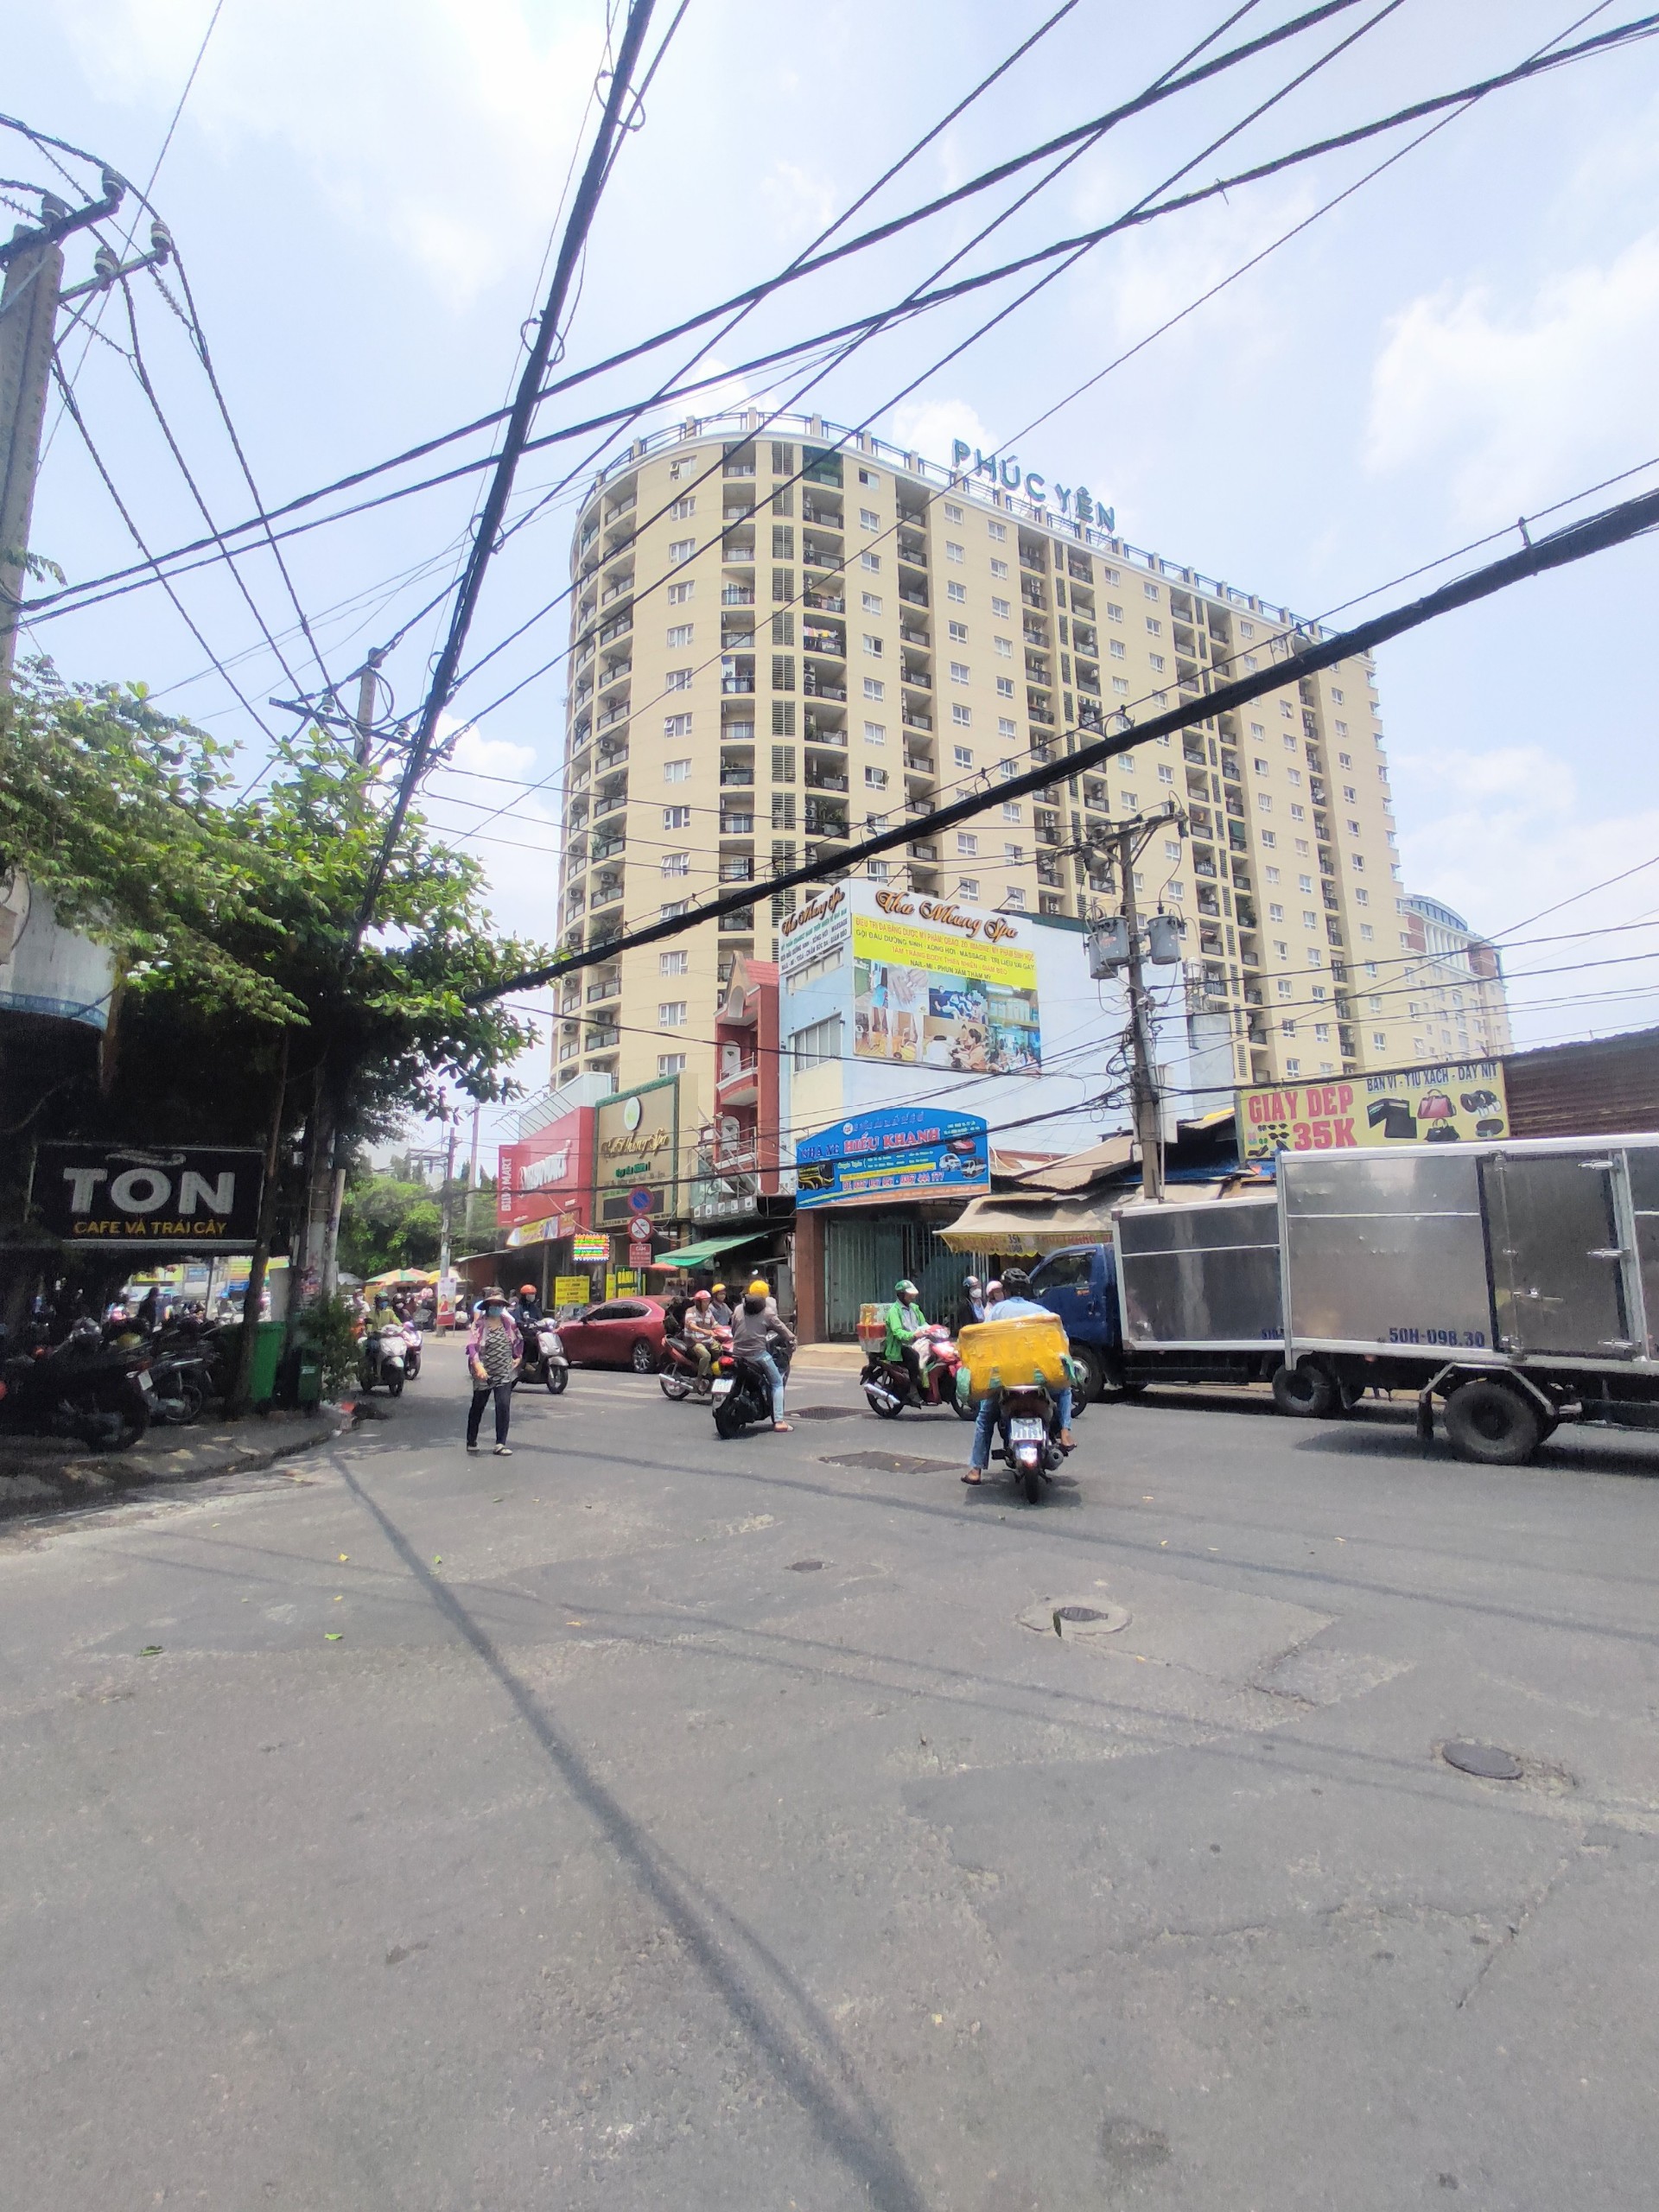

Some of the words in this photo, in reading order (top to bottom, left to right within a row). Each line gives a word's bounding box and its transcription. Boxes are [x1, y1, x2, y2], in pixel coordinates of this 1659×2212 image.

[952, 438, 1046, 502] PHÚC
[1055, 483, 1115, 533] YÊN
[875, 889, 915, 914] Thu
[919, 900, 982, 938] Nhung
[984, 917, 1019, 943] Spa
[882, 1128, 940, 1149] KHANH
[1293, 1118, 1357, 1151] 35K
[501, 1157, 512, 1185] MART
[73, 1221, 121, 1234] CAFE
[150, 1219, 190, 1234] TRÁI
[193, 1219, 227, 1234] CÂY
[1389, 1328, 1484, 1347] 50H-098.30
